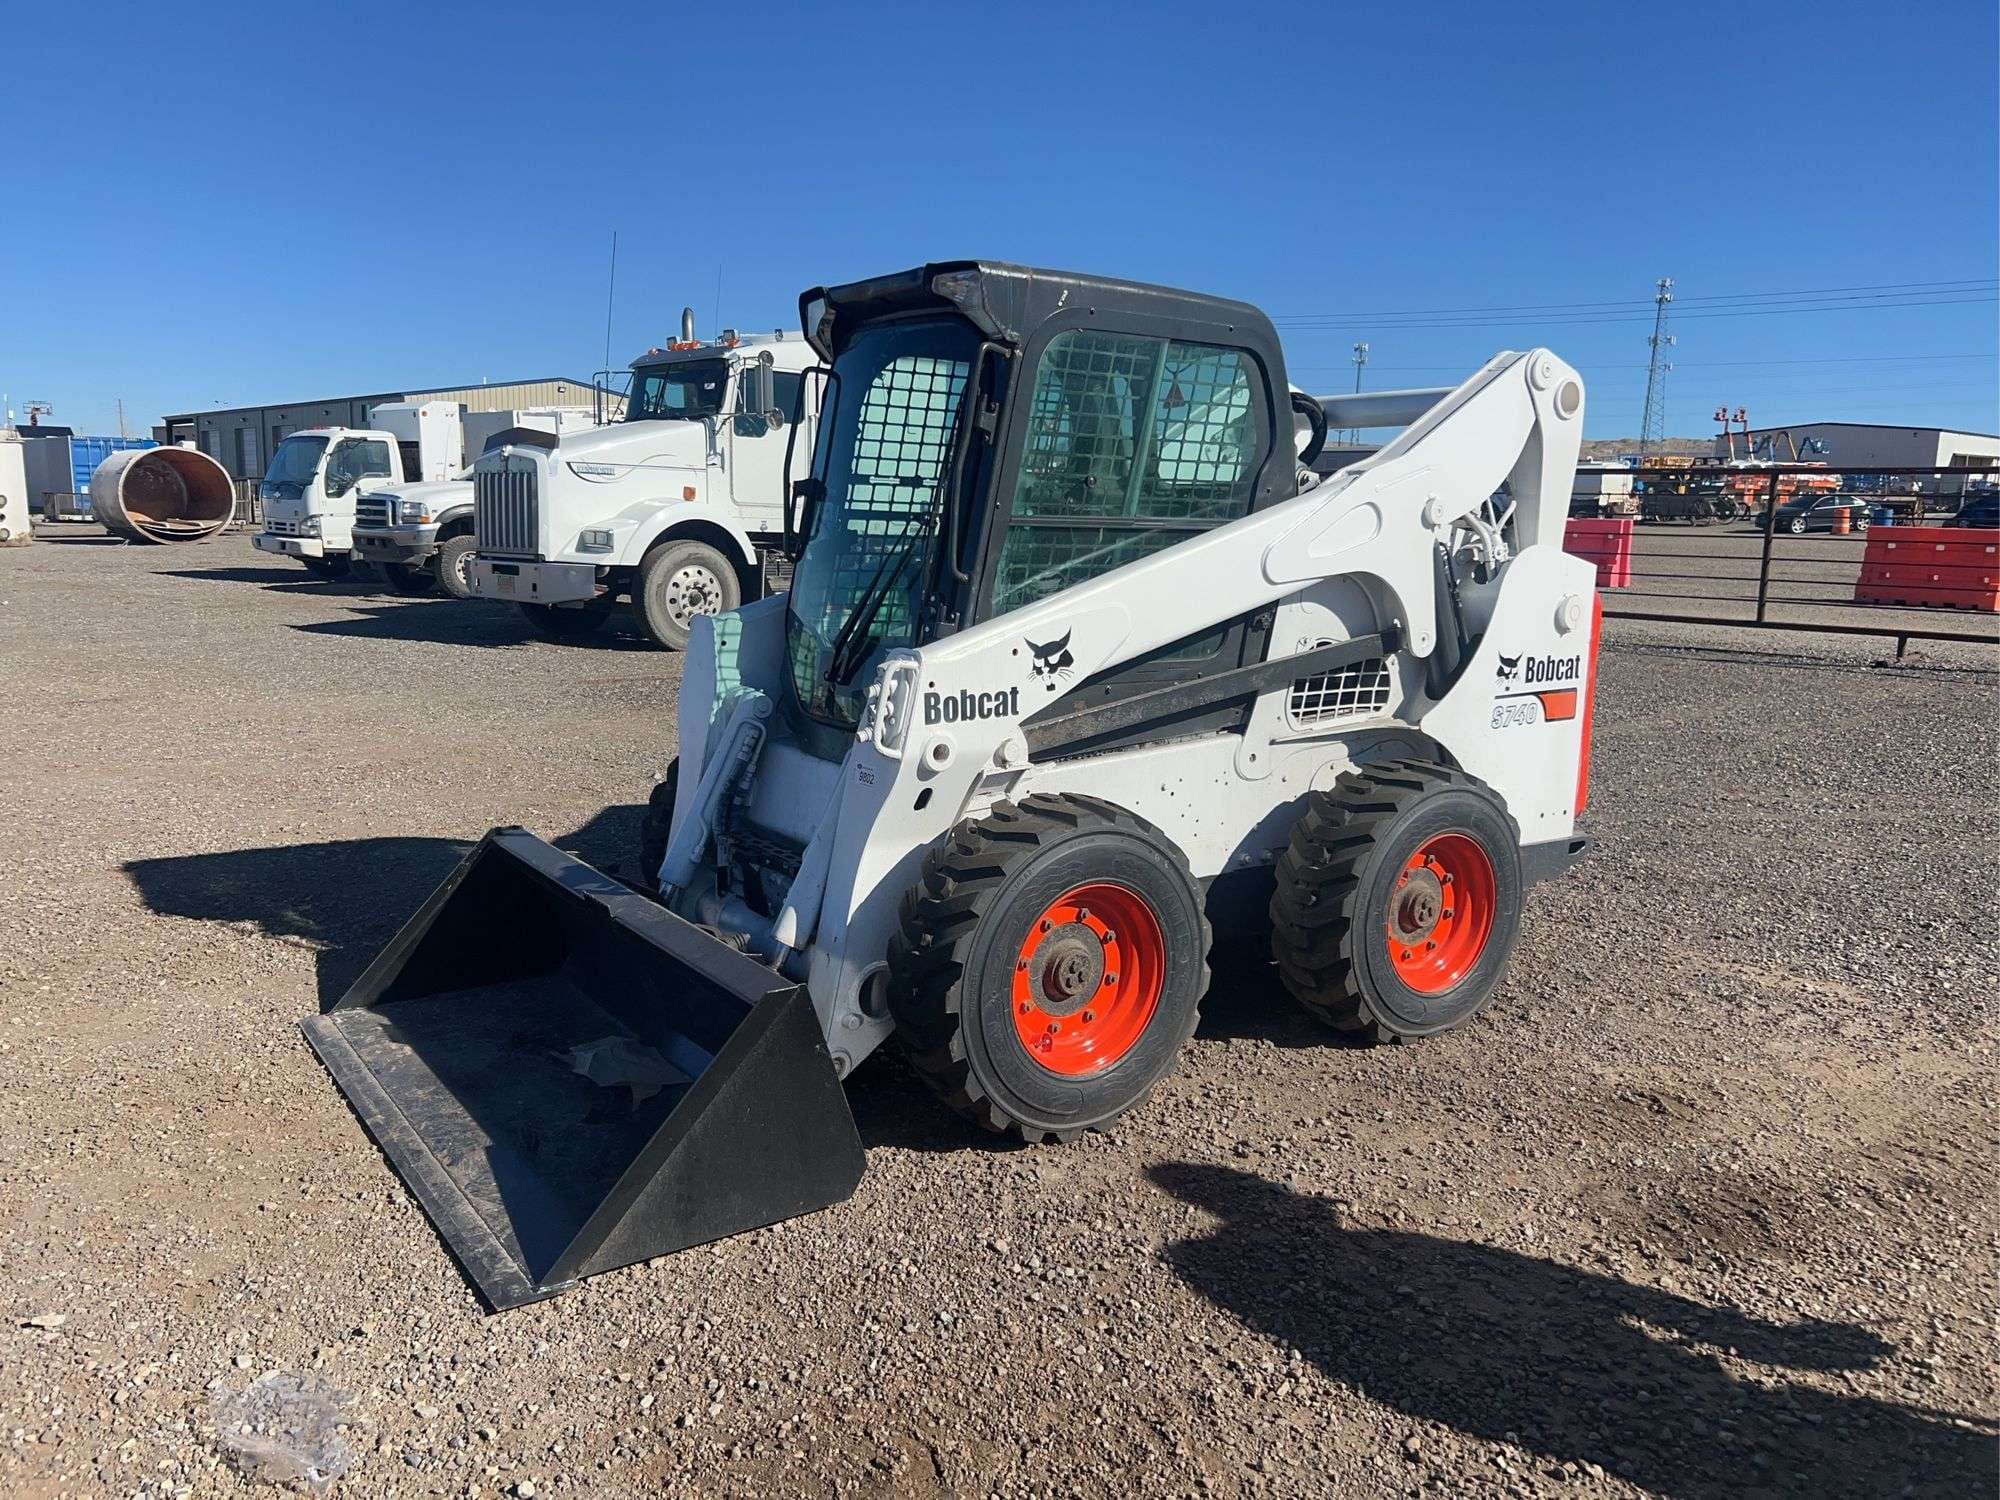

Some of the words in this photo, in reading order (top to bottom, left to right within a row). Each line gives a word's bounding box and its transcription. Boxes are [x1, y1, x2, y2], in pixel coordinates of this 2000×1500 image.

[1525, 655, 1580, 683] Bobcat
[924, 686, 1019, 725] Bobcat
[1490, 703, 1538, 729] S740
